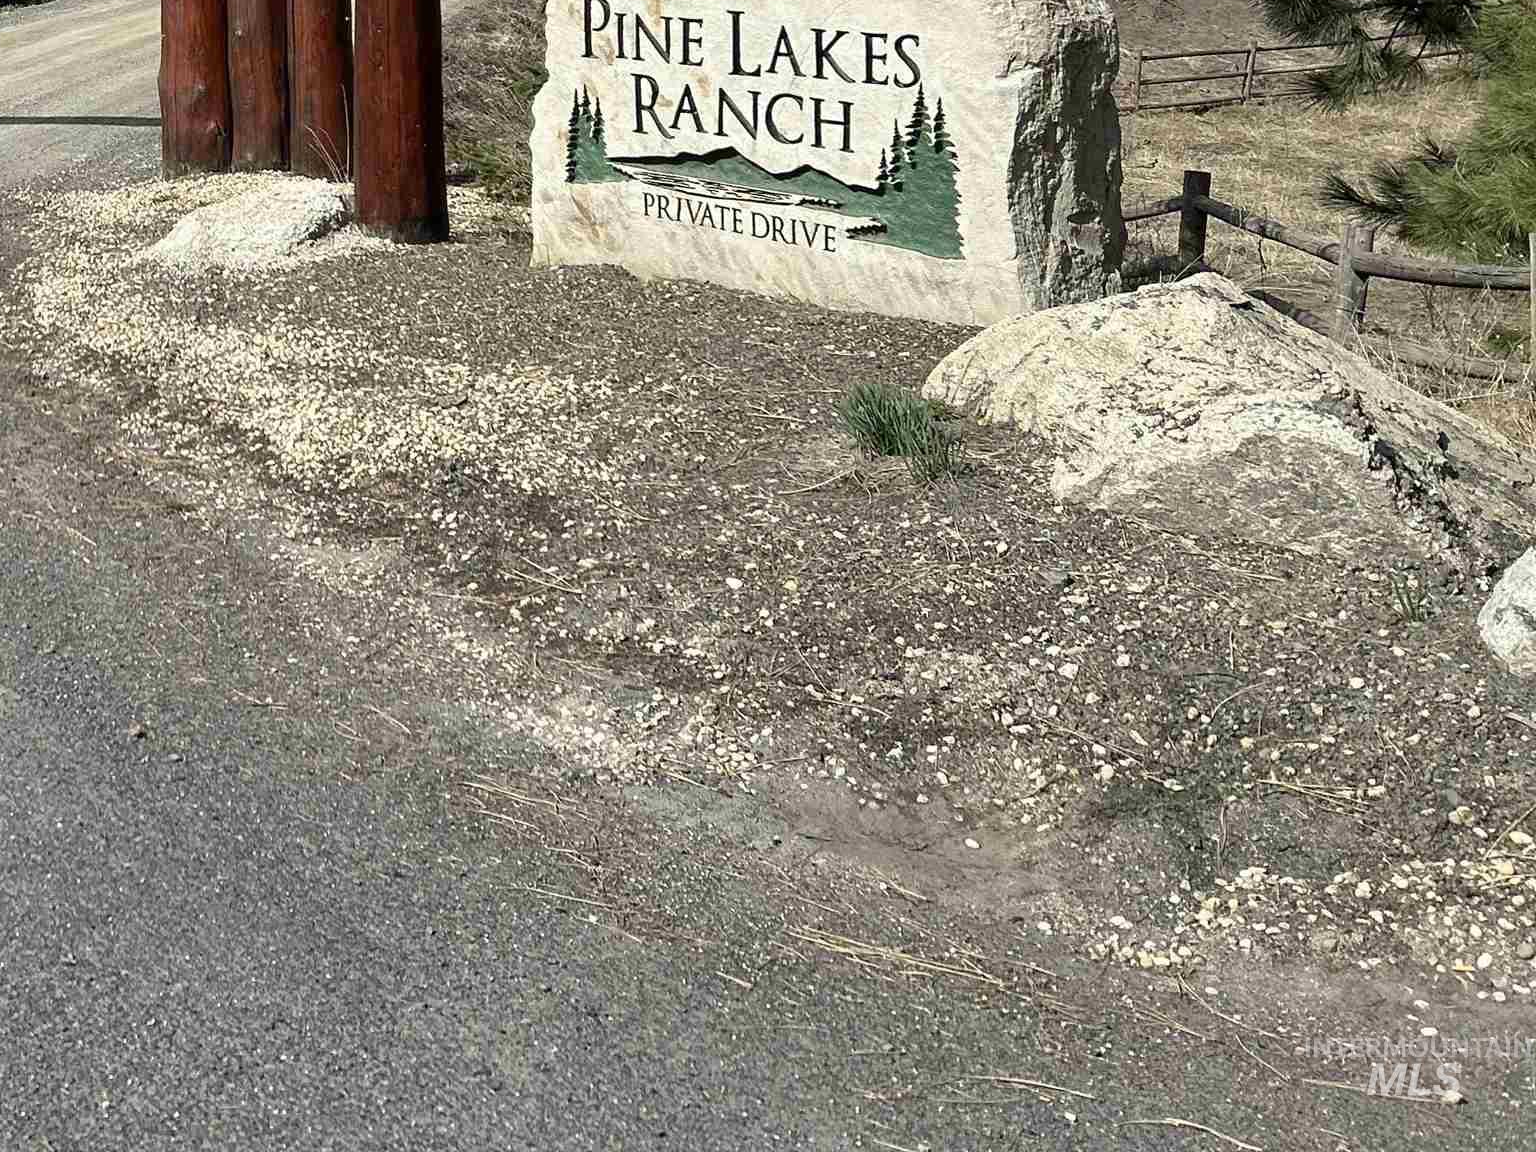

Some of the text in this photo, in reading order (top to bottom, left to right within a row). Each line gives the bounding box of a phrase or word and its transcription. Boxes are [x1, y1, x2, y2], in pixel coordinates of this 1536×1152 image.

[726, 10, 922, 89] LAKES
[630, 73, 854, 153] RANCH
[642, 192, 837, 253] PRIVATE DRIVE
